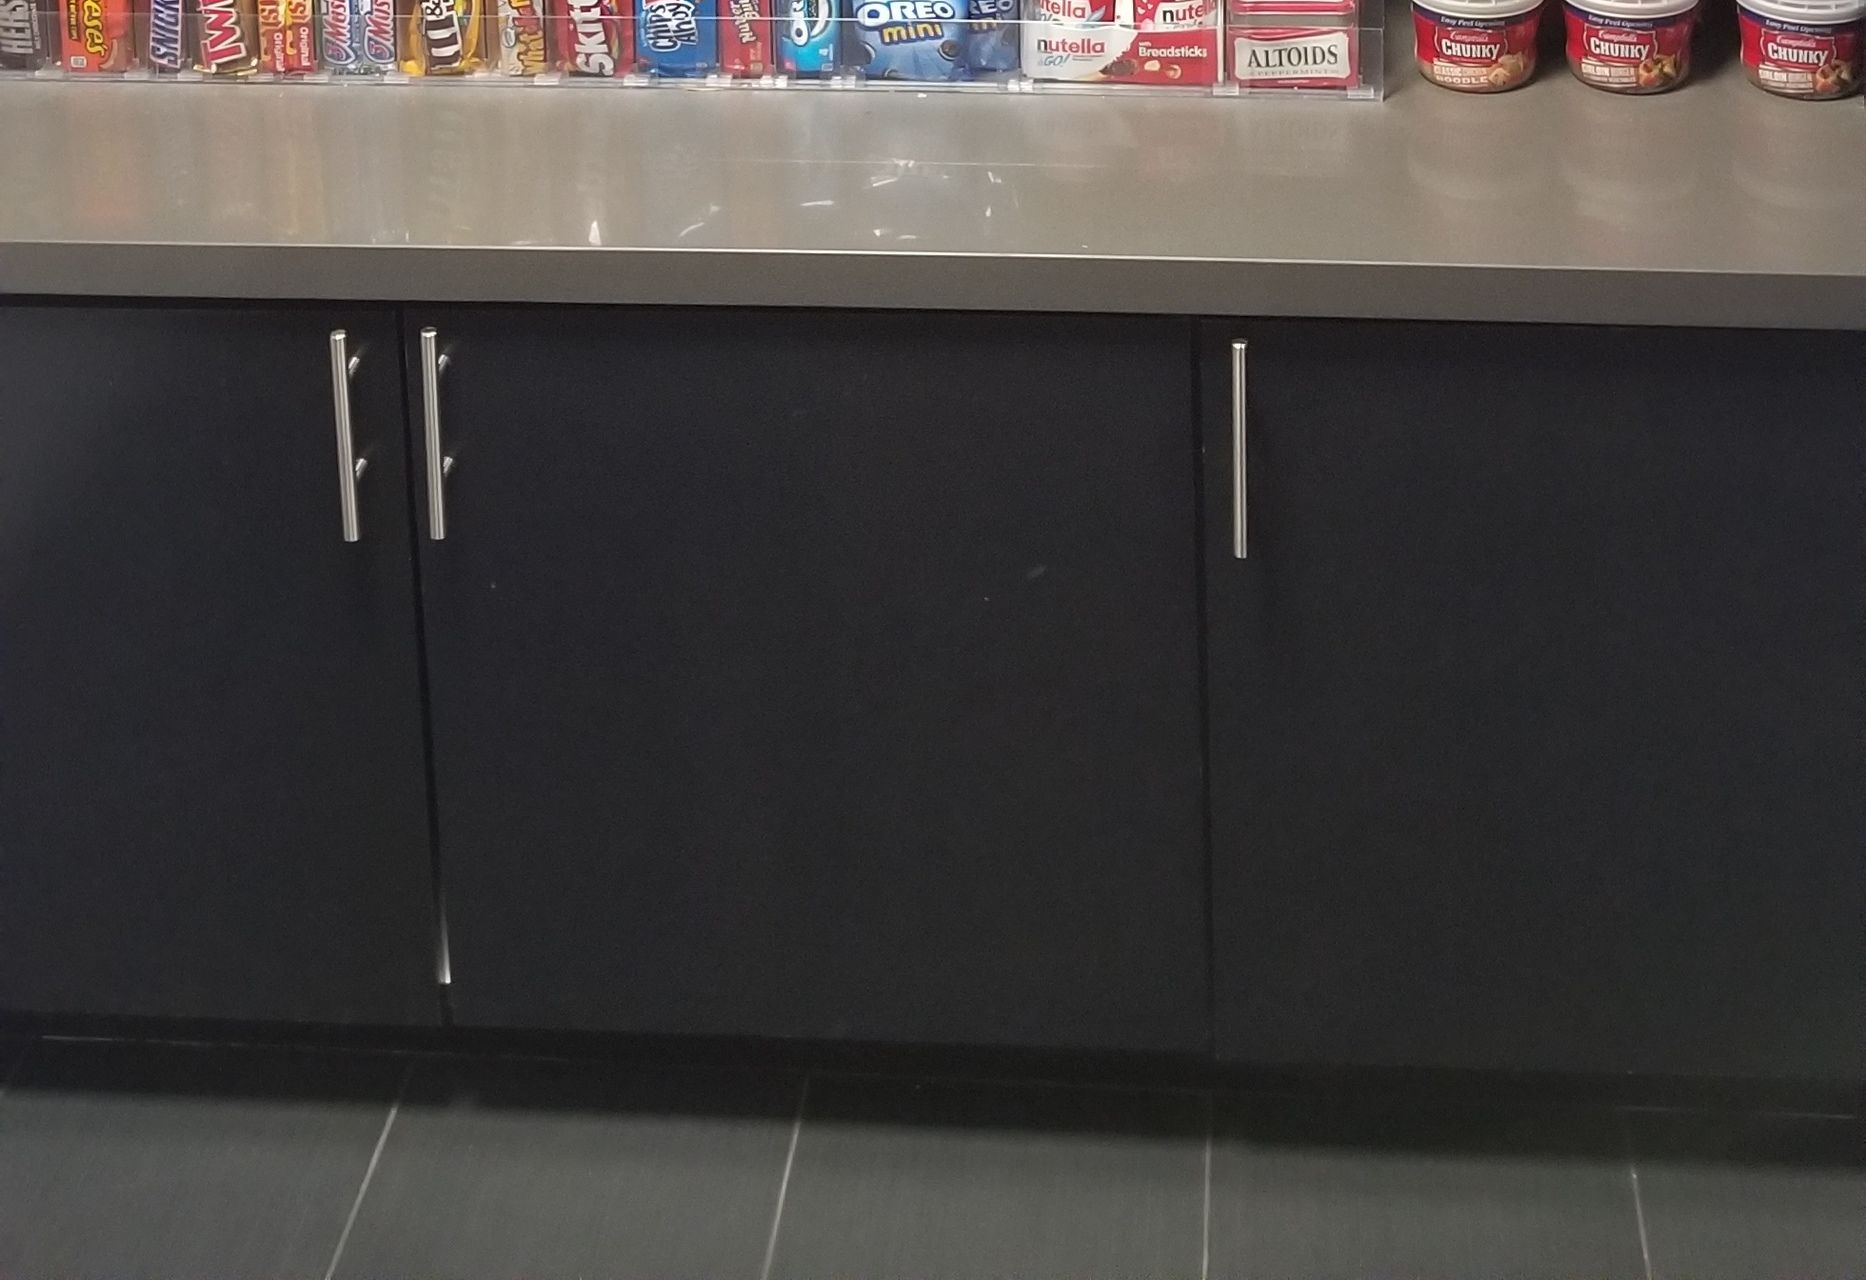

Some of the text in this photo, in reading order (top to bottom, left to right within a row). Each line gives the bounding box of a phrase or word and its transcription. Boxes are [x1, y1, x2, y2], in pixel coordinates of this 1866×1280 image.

[730, 0, 757, 43] Nutter
[857, 0, 955, 28] OREO
[882, 24, 943, 43] mini
[1037, 38, 1105, 54] nutella
[300, 27, 309, 66] original
[1138, 46, 1208, 58] Breadsticks
[1248, 44, 1338, 69] ALTOIDS
[1441, 38, 1500, 60] CHUNKY
[1590, 36, 1650, 61] CHUNKY
[1767, 42, 1829, 67] CHUNKY
